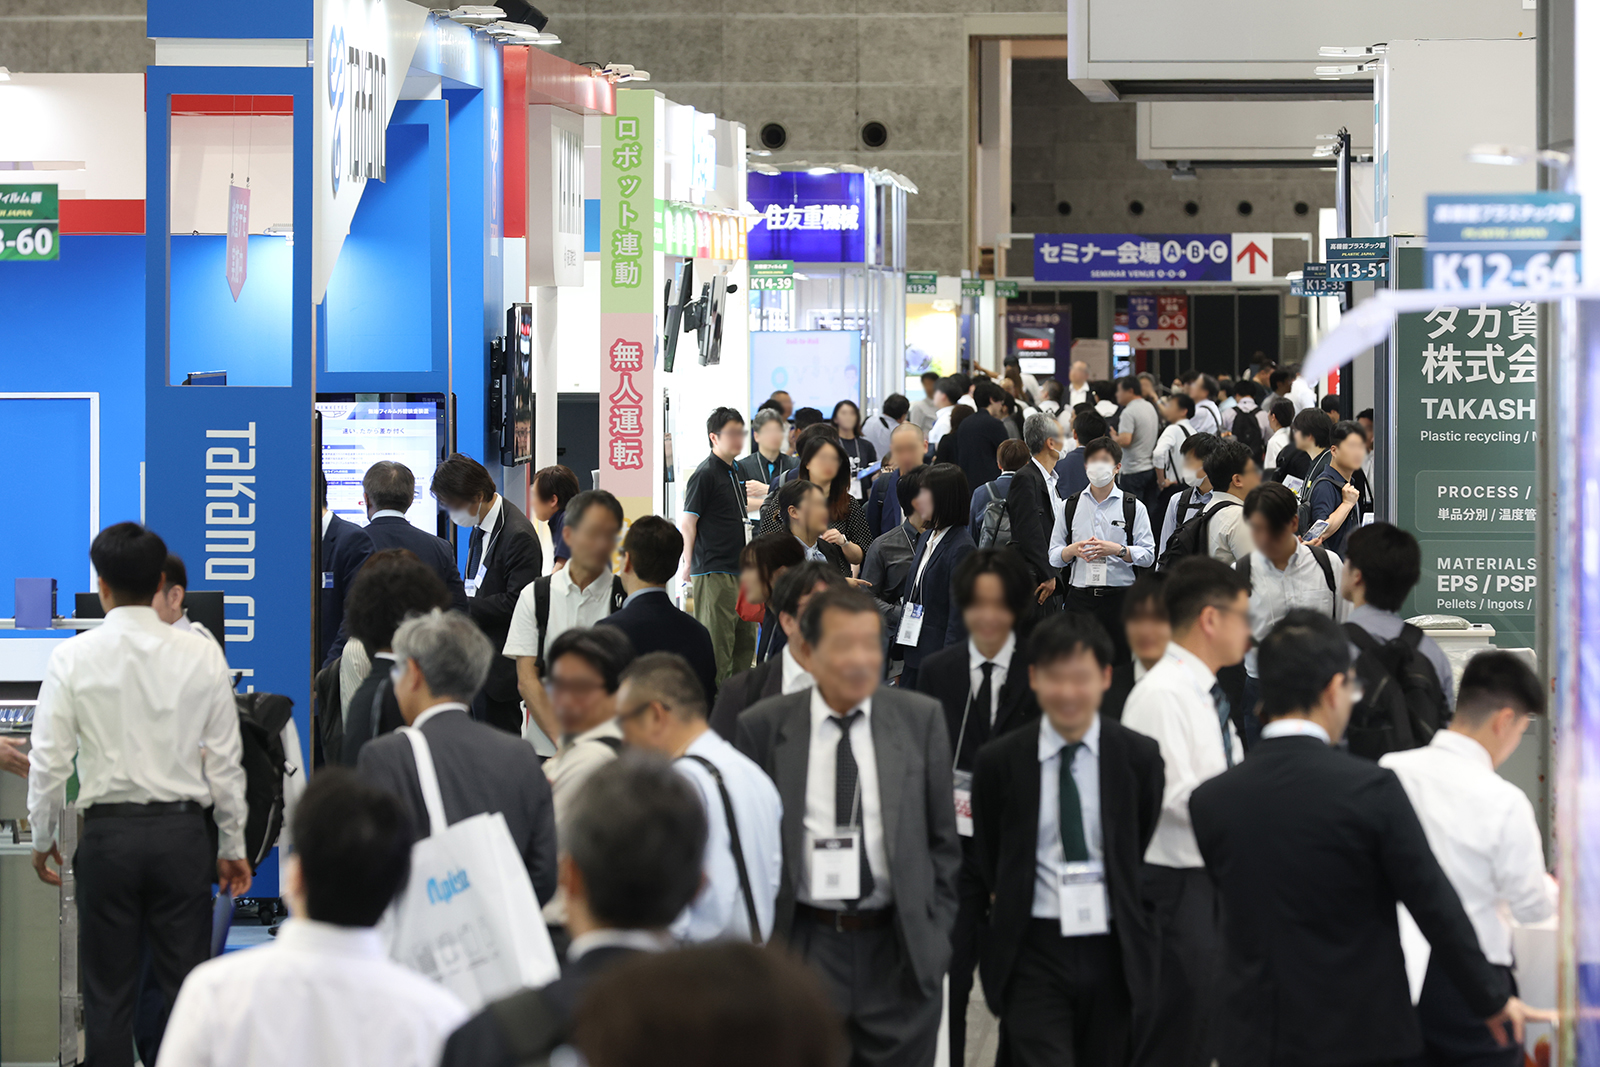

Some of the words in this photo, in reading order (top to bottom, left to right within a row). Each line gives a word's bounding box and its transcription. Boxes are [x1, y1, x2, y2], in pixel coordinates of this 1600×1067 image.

[612, 117, 643, 288] ロボット連動
[1090, 269, 1127, 278] SEMINAR
[1128, 269, 1156, 278] VENUE
[1330, 262, 1386, 278] K13-51
[1432, 252, 1578, 291] K12-64
[750, 278, 792, 290] K14-39
[1306, 280, 1346, 291] K13-35
[610, 339, 643, 469] 無人運転
[1420, 398, 1536, 420] TAKASH
[1420, 430, 1461, 441] Plastic
[1464, 430, 1521, 444] recycling
[1437, 486, 1519, 498] PROCESS
[1525, 485, 1532, 500] /
[1437, 508, 1488, 521] 単品分別
[1437, 557, 1537, 570] MATERIALS
[1437, 575, 1478, 592] EPS
[1482, 574, 1492, 594] /
[1496, 575, 1537, 592] PSP
[1437, 598, 1477, 609] Pellets
[1487, 599, 1525, 611] Ingots
